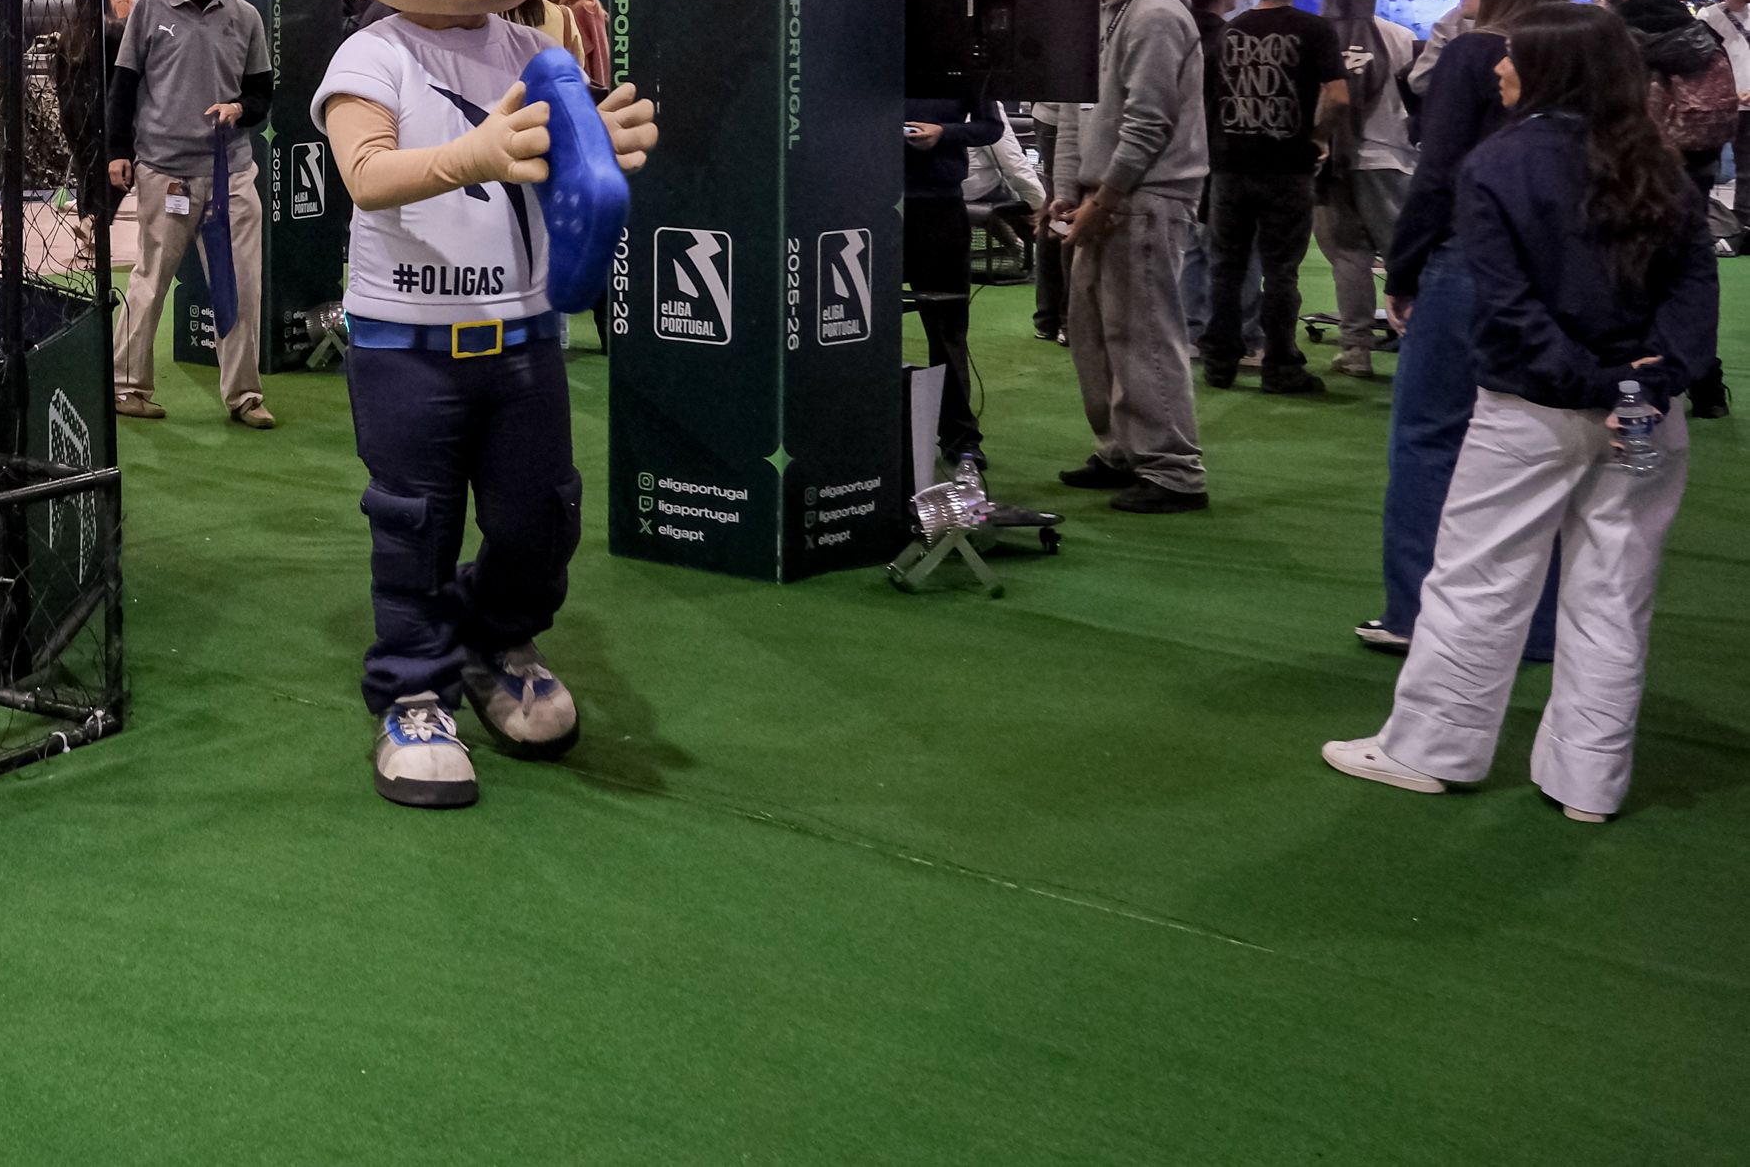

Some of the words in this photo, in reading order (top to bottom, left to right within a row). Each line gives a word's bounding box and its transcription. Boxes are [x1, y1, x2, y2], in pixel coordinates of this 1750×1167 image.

[788, 0, 801, 150] PORTUGAL
[272, 147, 281, 222] 2025-26
[294, 201, 318, 214] PORTUGAL
[787, 237, 799, 351] 2025-26
[661, 300, 692, 317] eLIGA
[822, 304, 845, 321] eLIGA
[661, 316, 716, 337] PORTUGAL
[822, 319, 861, 339] PORTUGAL
[658, 477, 748, 501] eligaportugal
[819, 476, 882, 499] eligaportugal
[658, 499, 740, 523] ligaportugal
[819, 501, 876, 522] ligaportugal
[658, 524, 705, 542] eligapt
[818, 530, 851, 546] eligapt
